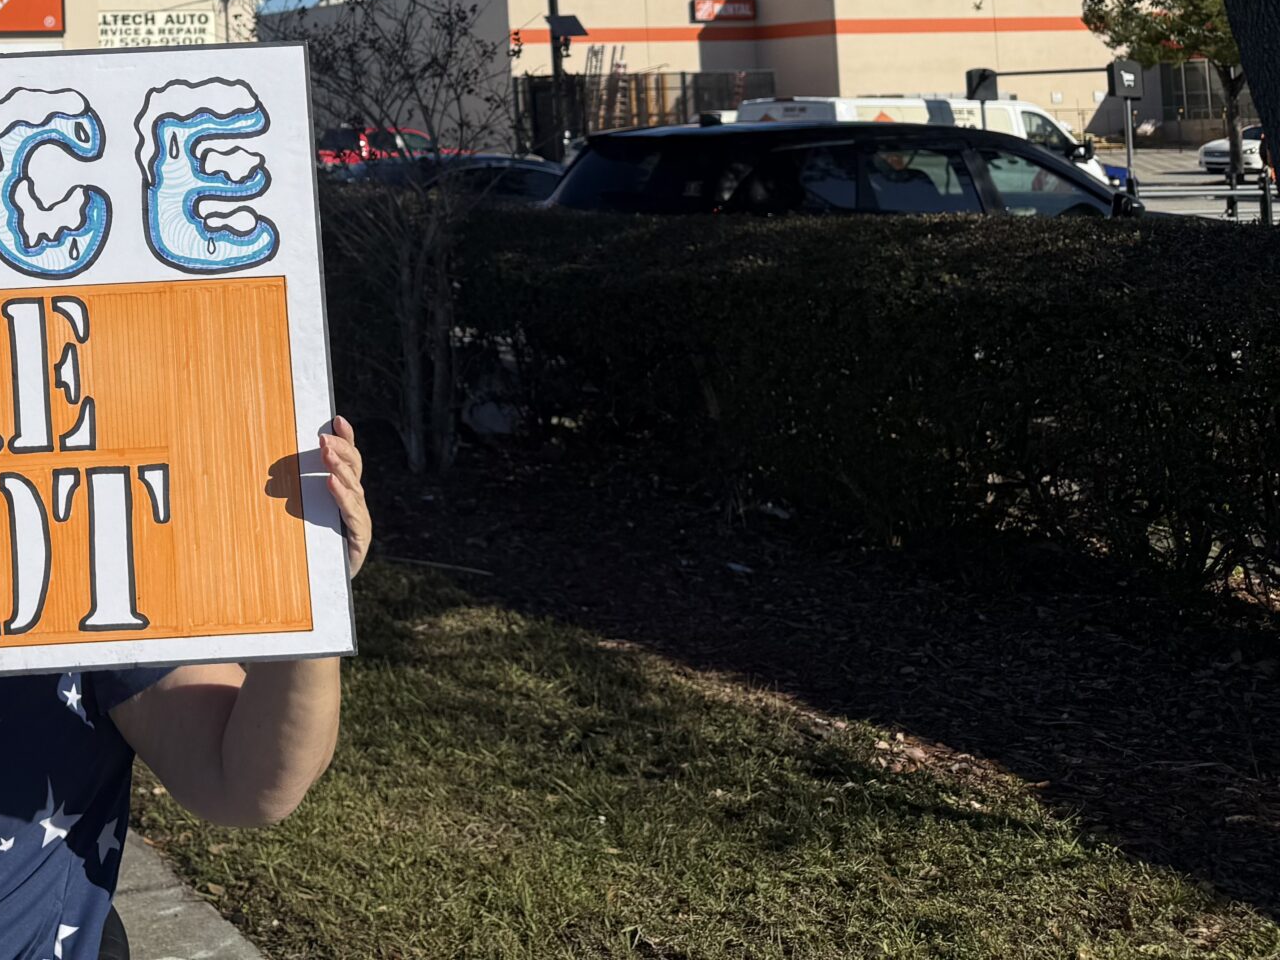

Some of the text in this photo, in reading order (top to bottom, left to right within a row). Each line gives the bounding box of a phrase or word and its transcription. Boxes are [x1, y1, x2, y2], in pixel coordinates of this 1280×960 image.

[98, 13, 209, 26] LTECH AUTO
[99, 27, 140, 36] RVICE
[158, 27, 207, 35] REPAIR
